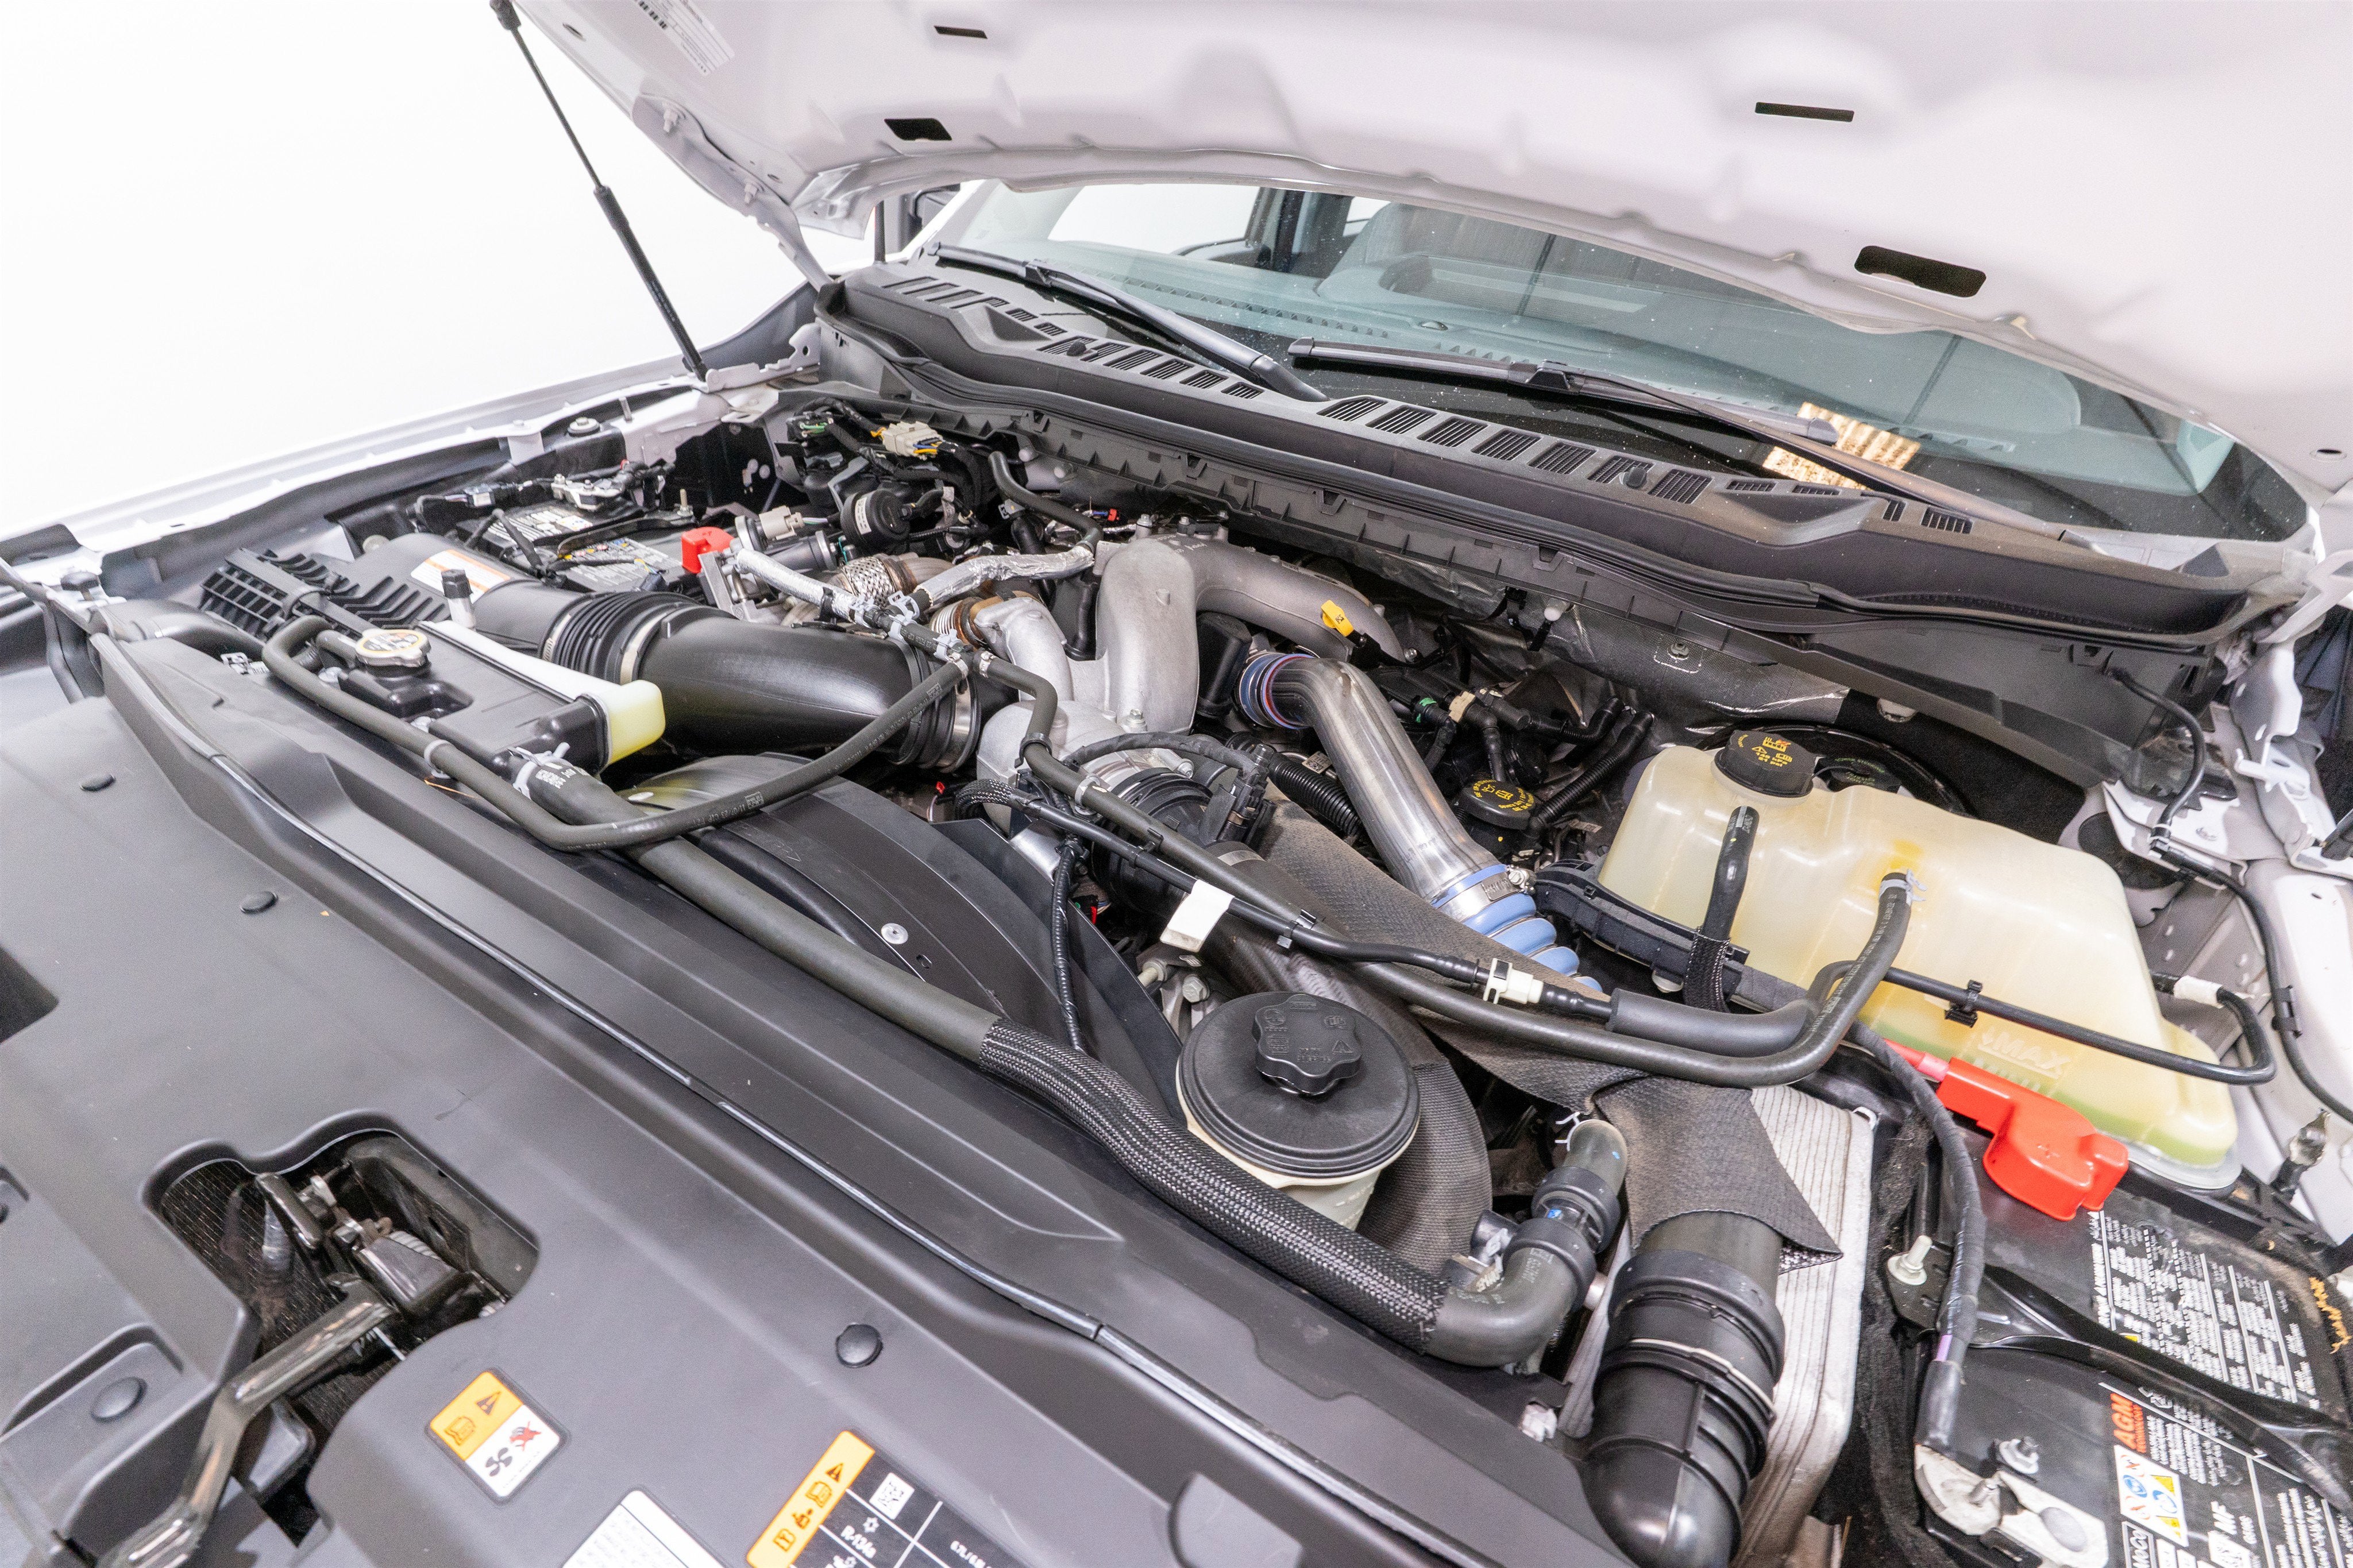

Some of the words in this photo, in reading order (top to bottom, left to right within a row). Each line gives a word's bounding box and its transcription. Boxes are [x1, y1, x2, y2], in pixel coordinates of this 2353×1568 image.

[1992, 1031, 2072, 1075] MAX
[2110, 1393, 2139, 1450] AGM
[840, 1525, 877, 1558] R-134a
